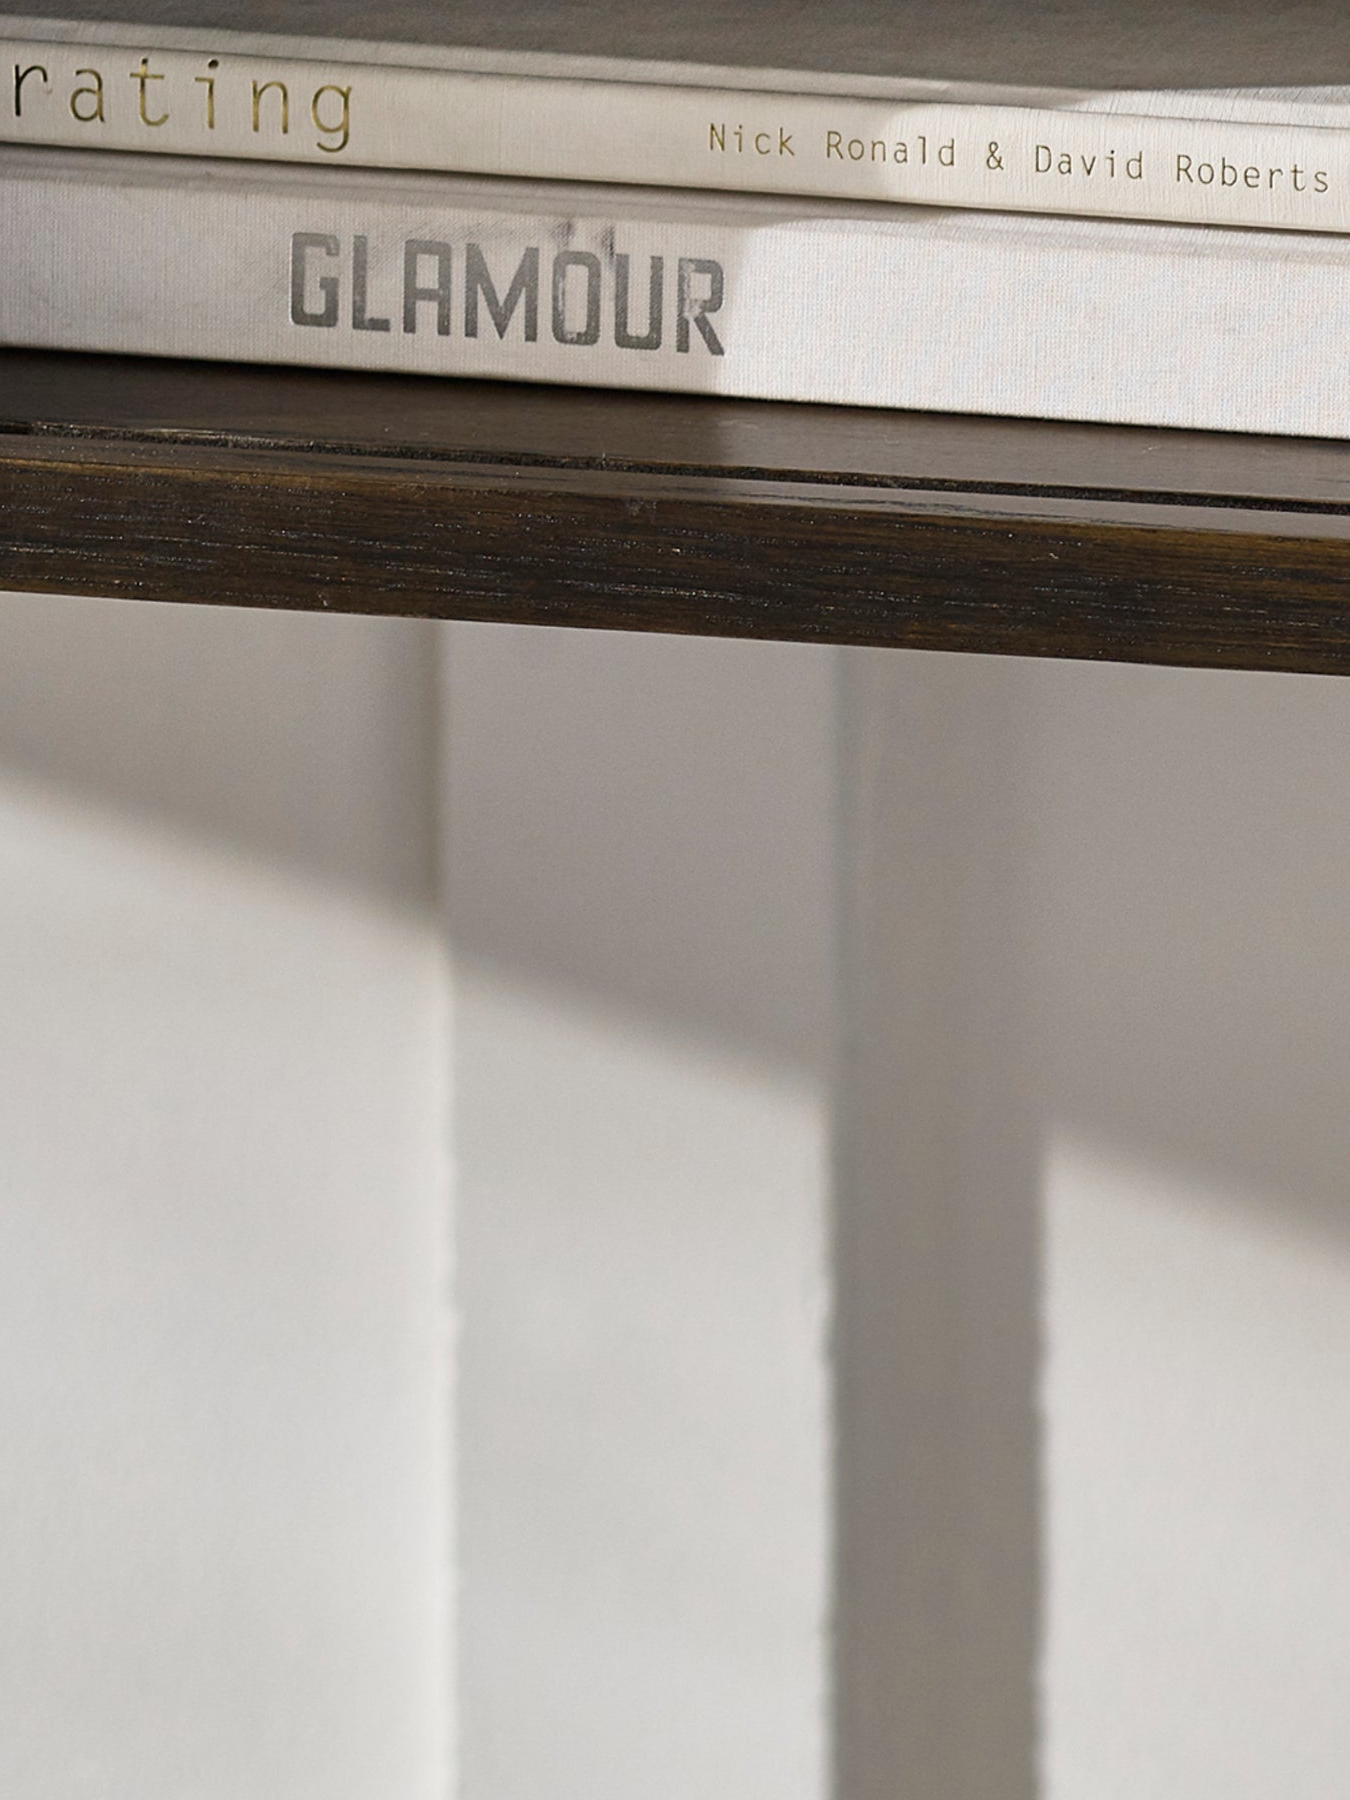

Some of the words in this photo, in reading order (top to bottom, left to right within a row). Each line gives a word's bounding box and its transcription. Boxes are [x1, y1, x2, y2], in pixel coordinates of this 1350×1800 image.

[708, 122, 795, 157] Nick
[825, 130, 956, 168] Ronald
[985, 140, 1005, 171] &
[1034, 145, 1143, 180] David
[1175, 153, 1330, 193] Roberts
[290, 232, 726, 357] GLAMOUR
